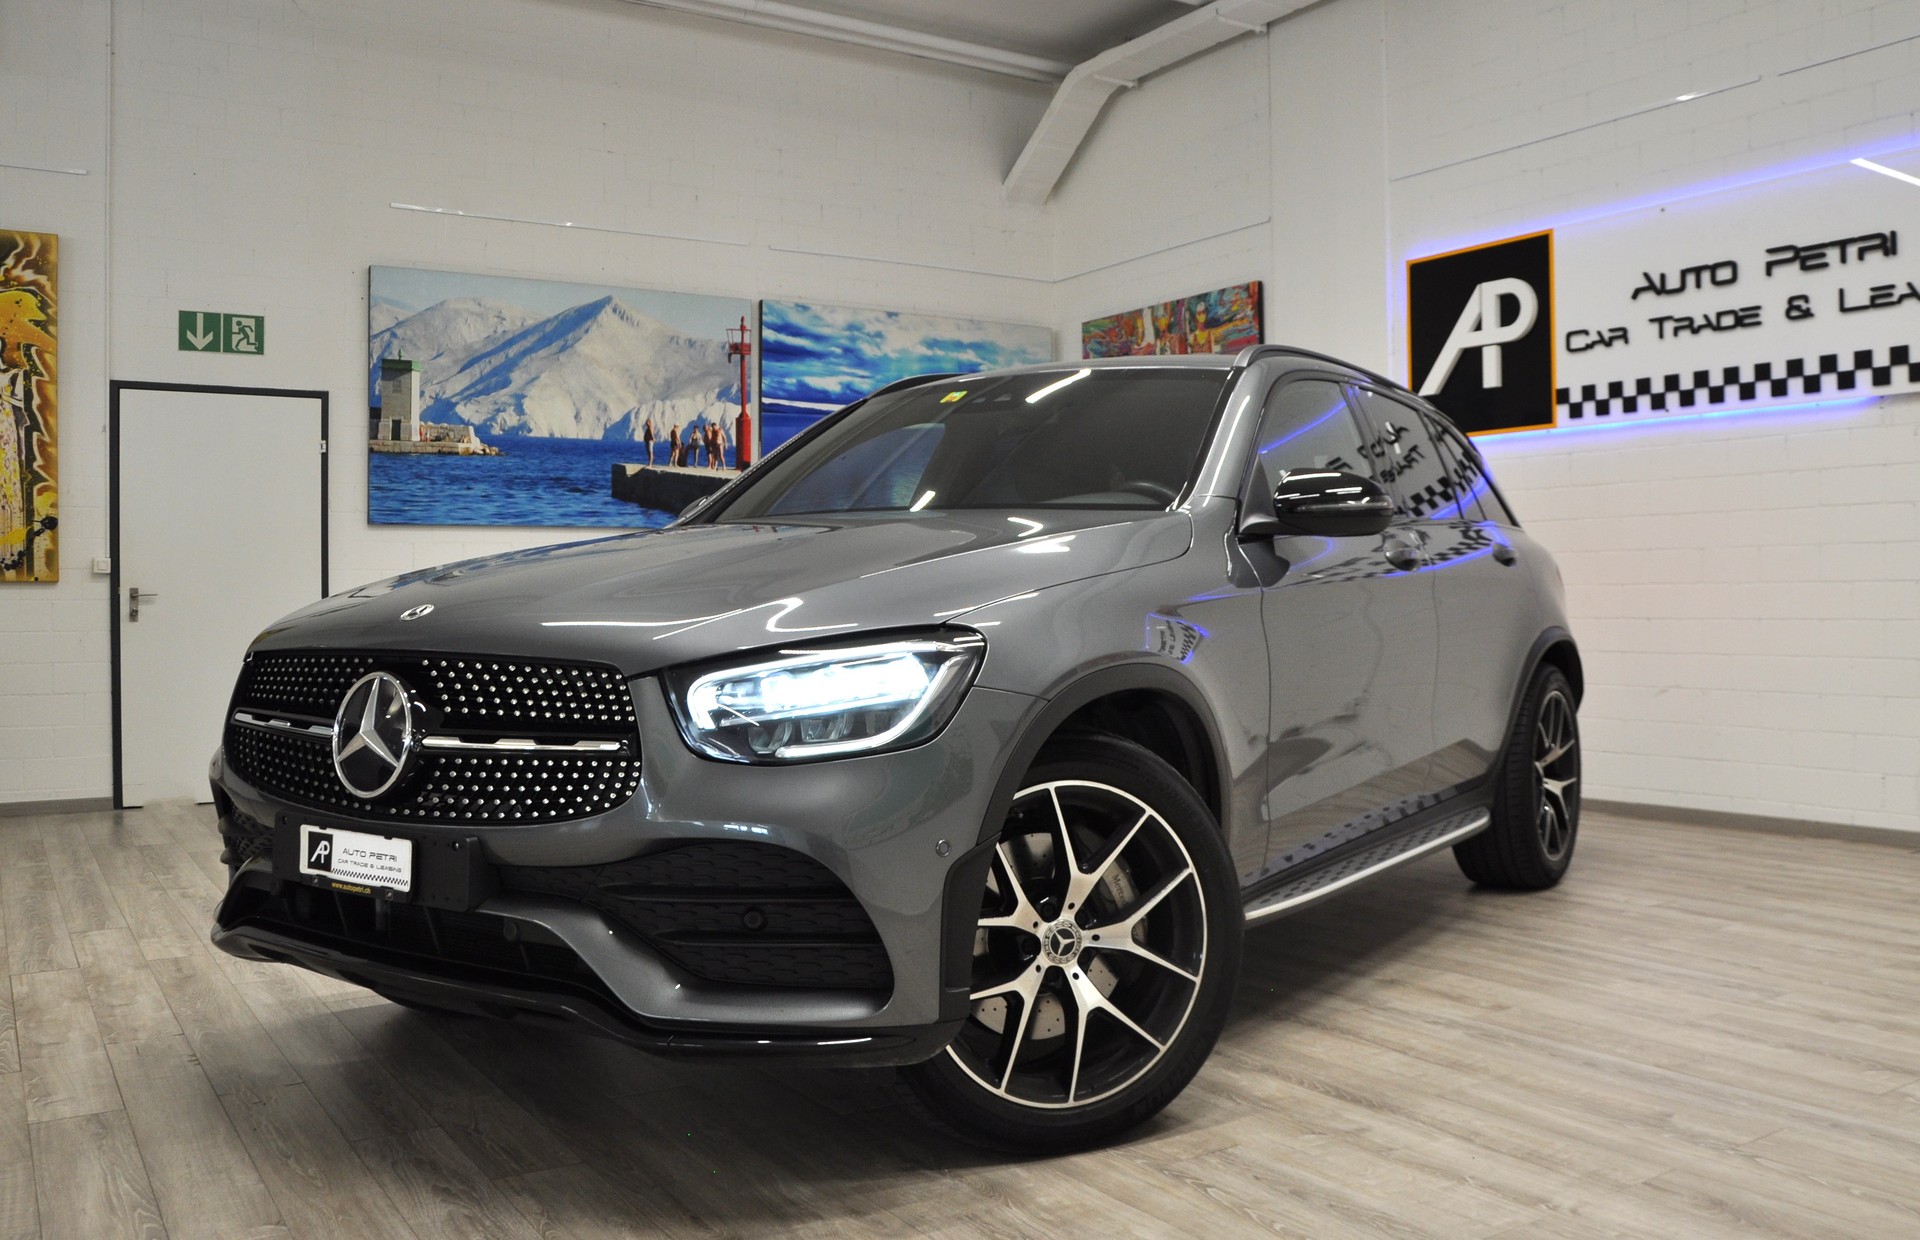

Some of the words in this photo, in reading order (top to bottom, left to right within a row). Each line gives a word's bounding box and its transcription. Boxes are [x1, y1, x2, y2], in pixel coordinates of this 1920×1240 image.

[1631, 260, 1737, 300] AUTO
[1765, 230, 1897, 277] PETRI
[1565, 327, 1629, 352] CAR
[1648, 305, 1762, 339] TRADE
[1785, 294, 1814, 320] &
[342, 847, 367, 858] AUTO
[369, 851, 398, 862] PETRI
[350, 860, 369, 868] TRADE
[376, 864, 402, 873] LEASING
